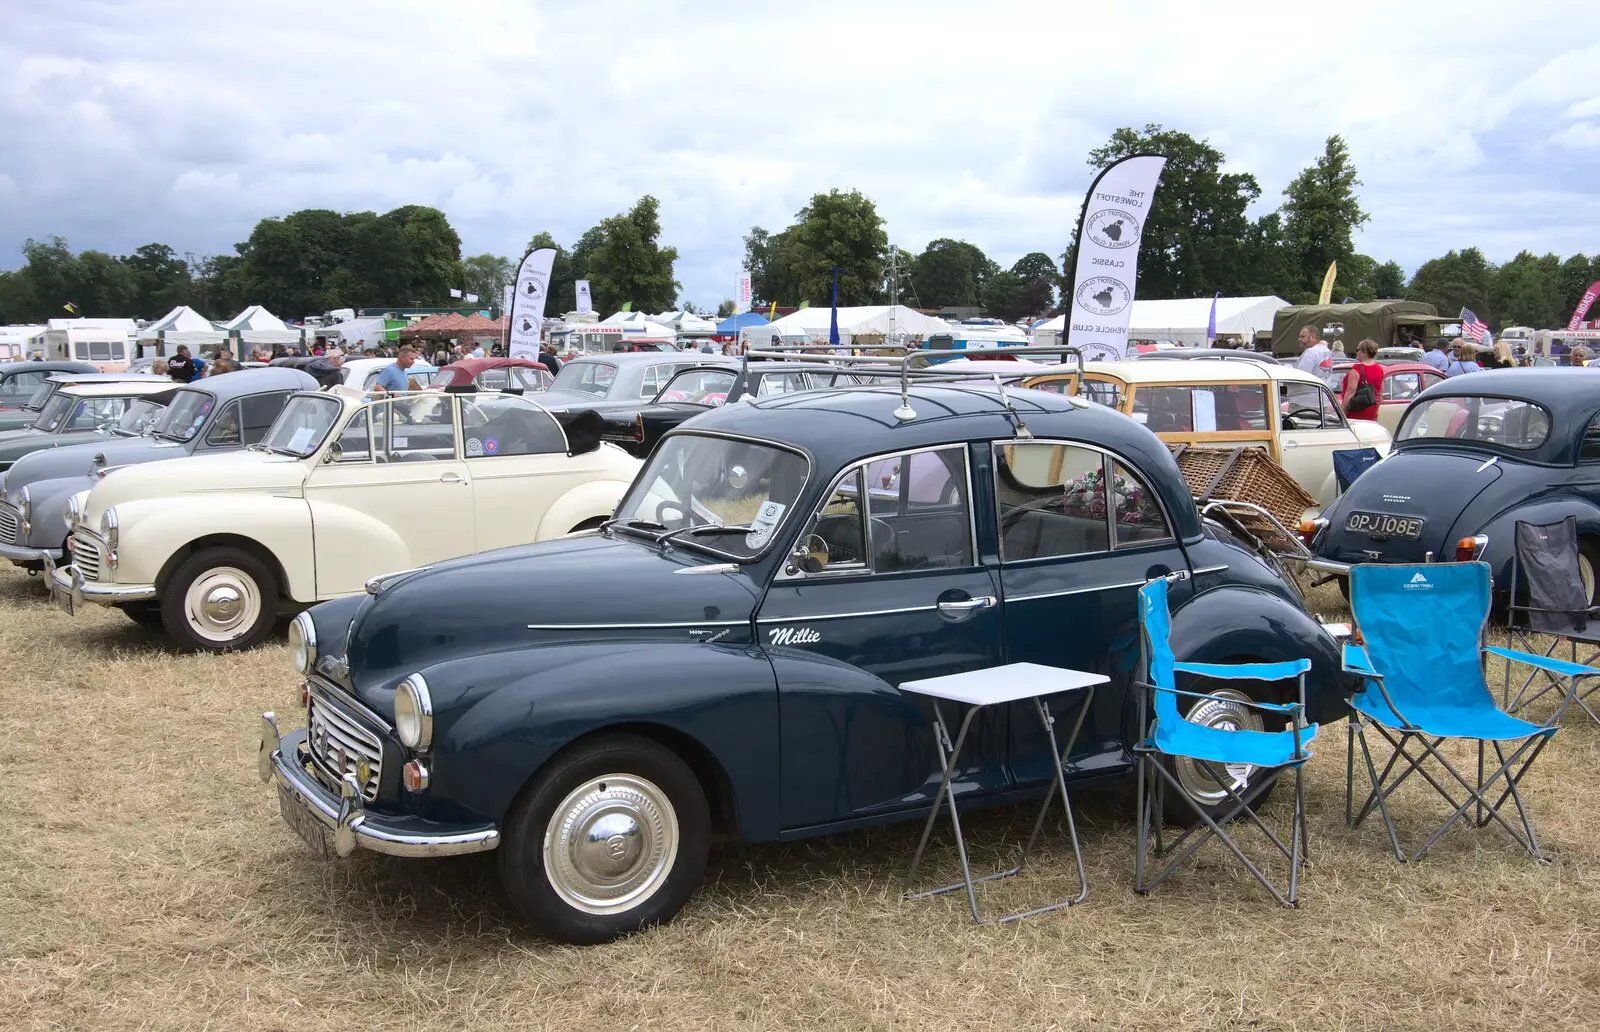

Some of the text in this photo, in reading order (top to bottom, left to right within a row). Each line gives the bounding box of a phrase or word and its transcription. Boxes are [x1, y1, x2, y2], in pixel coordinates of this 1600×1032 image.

[1568, 290, 1596, 332] HOG ROAST
[768, 627, 821, 645] Millie
